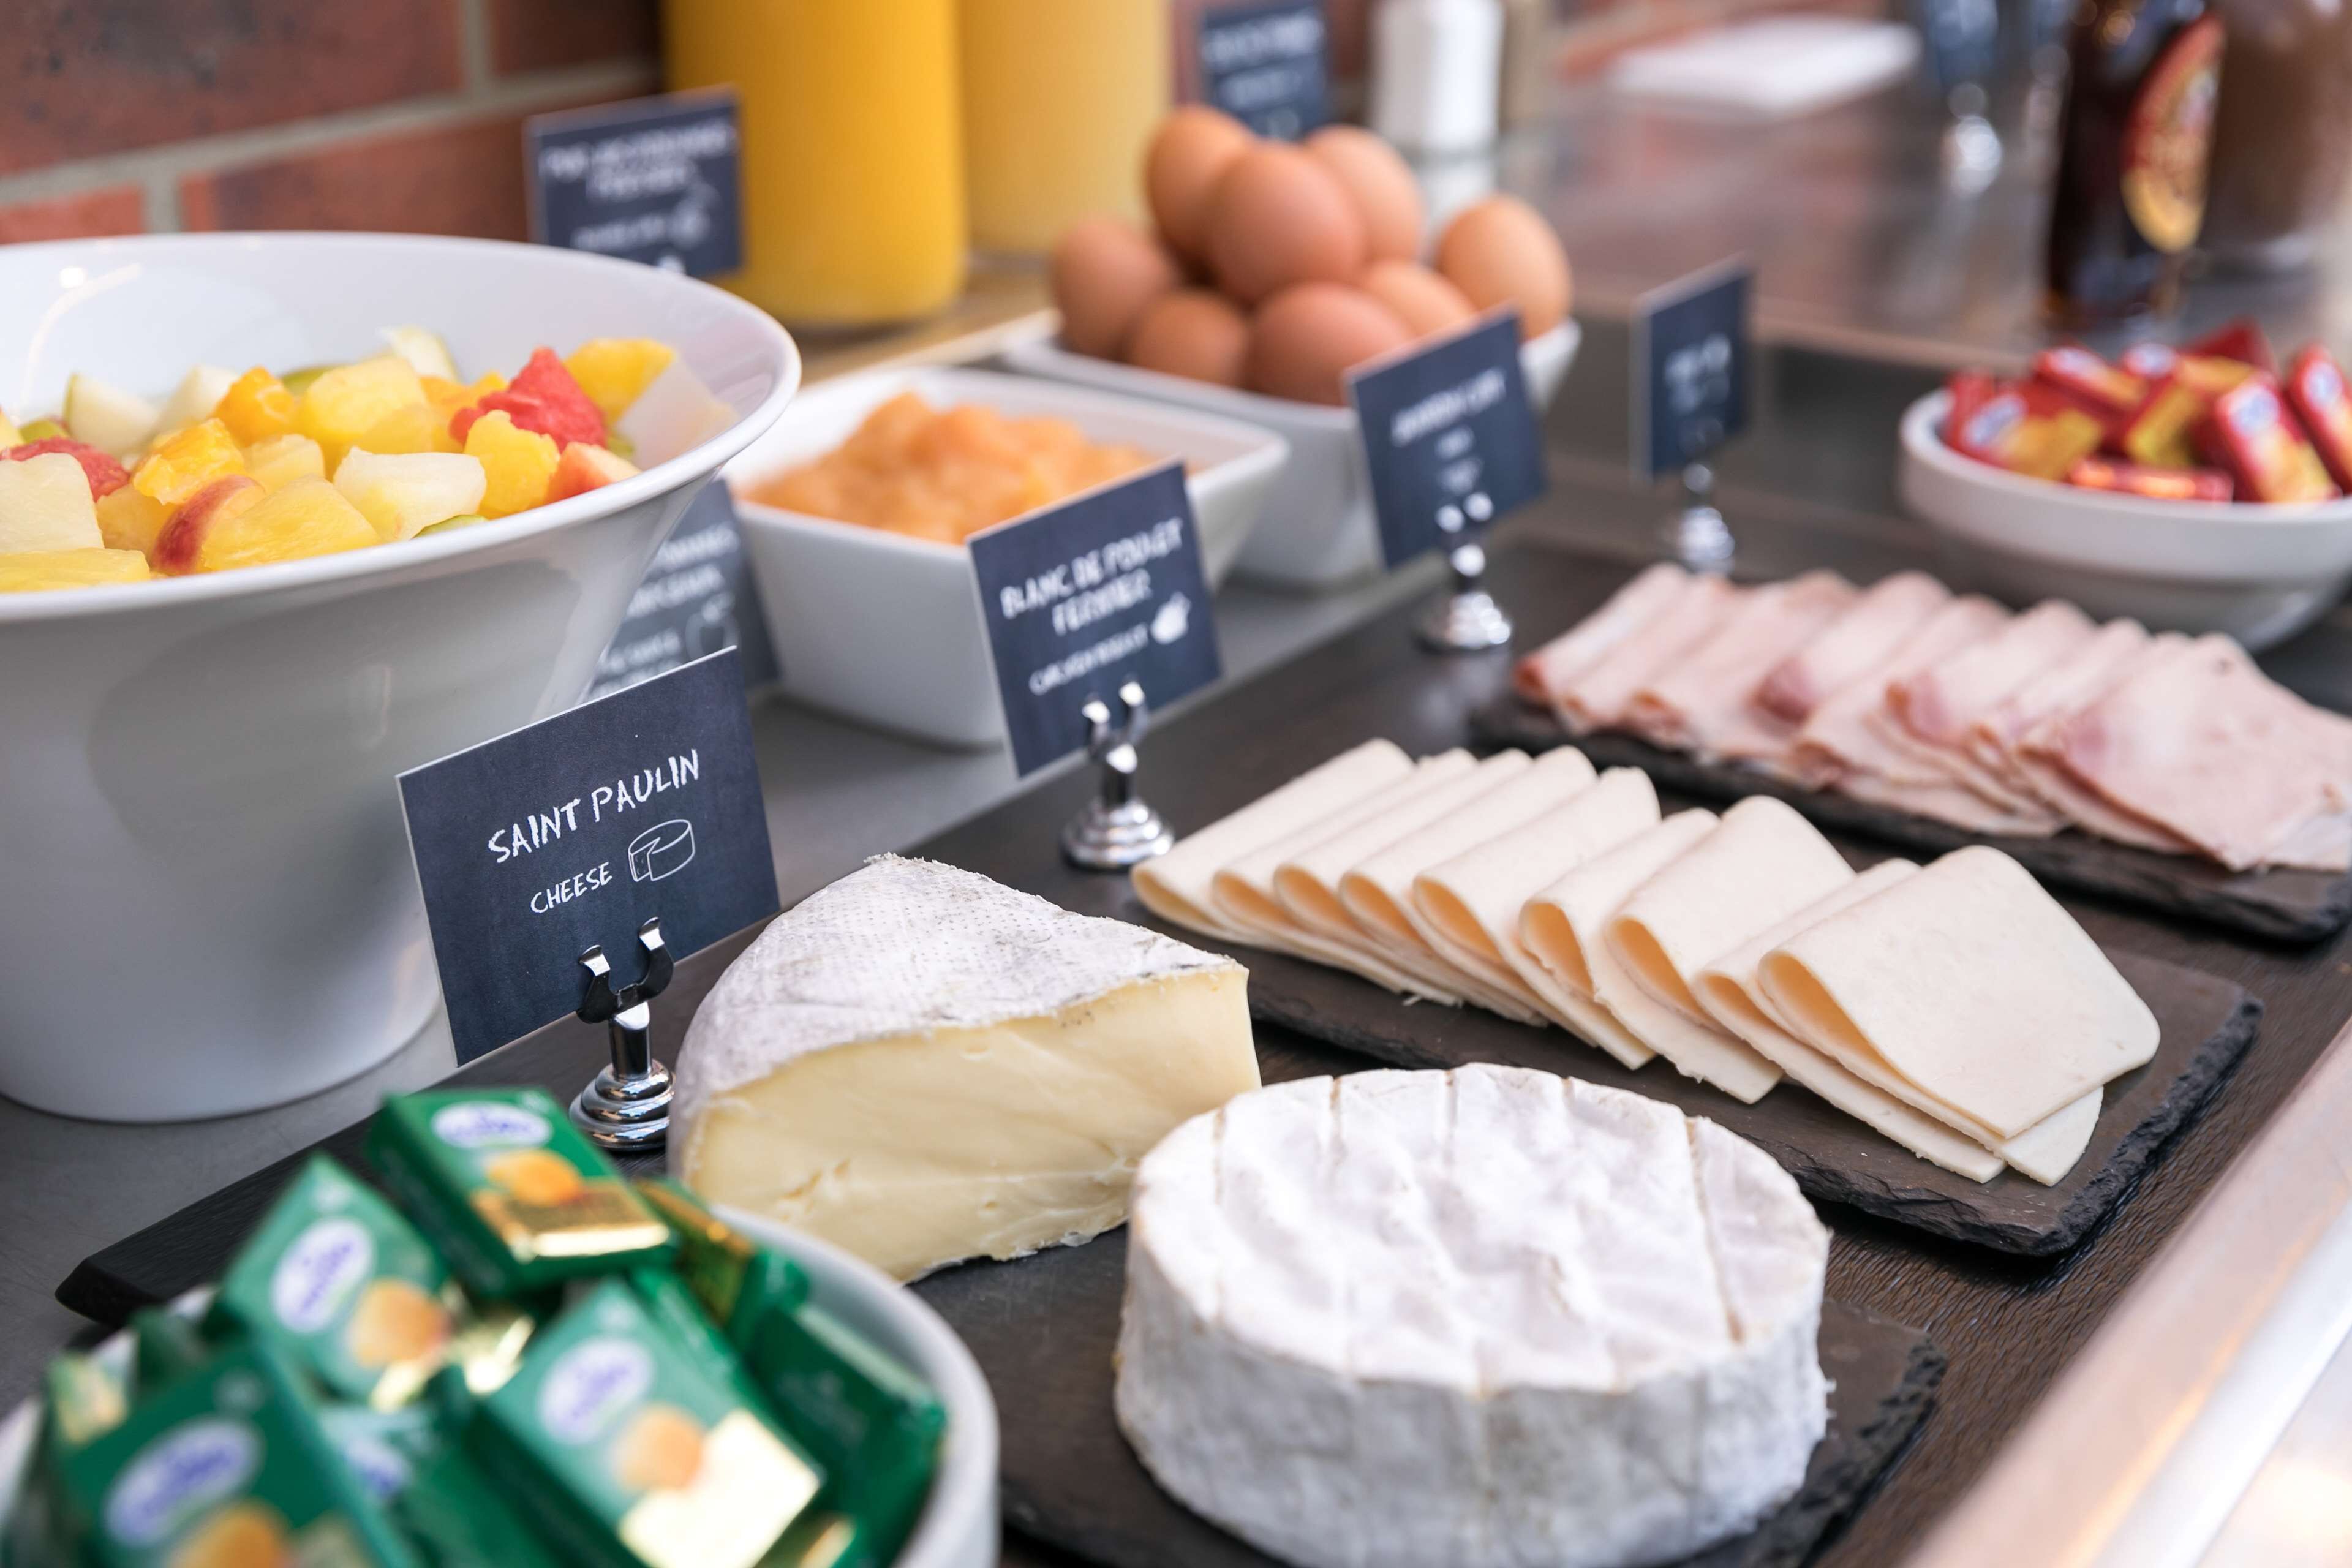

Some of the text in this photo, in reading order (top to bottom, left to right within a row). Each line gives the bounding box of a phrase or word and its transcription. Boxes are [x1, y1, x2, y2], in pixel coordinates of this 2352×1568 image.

[1001, 565, 1074, 618] BLANC
[1072, 551, 1103, 589] DE
[488, 748, 699, 863] SAINT PAULIN
[530, 861, 613, 913] CHEESE
